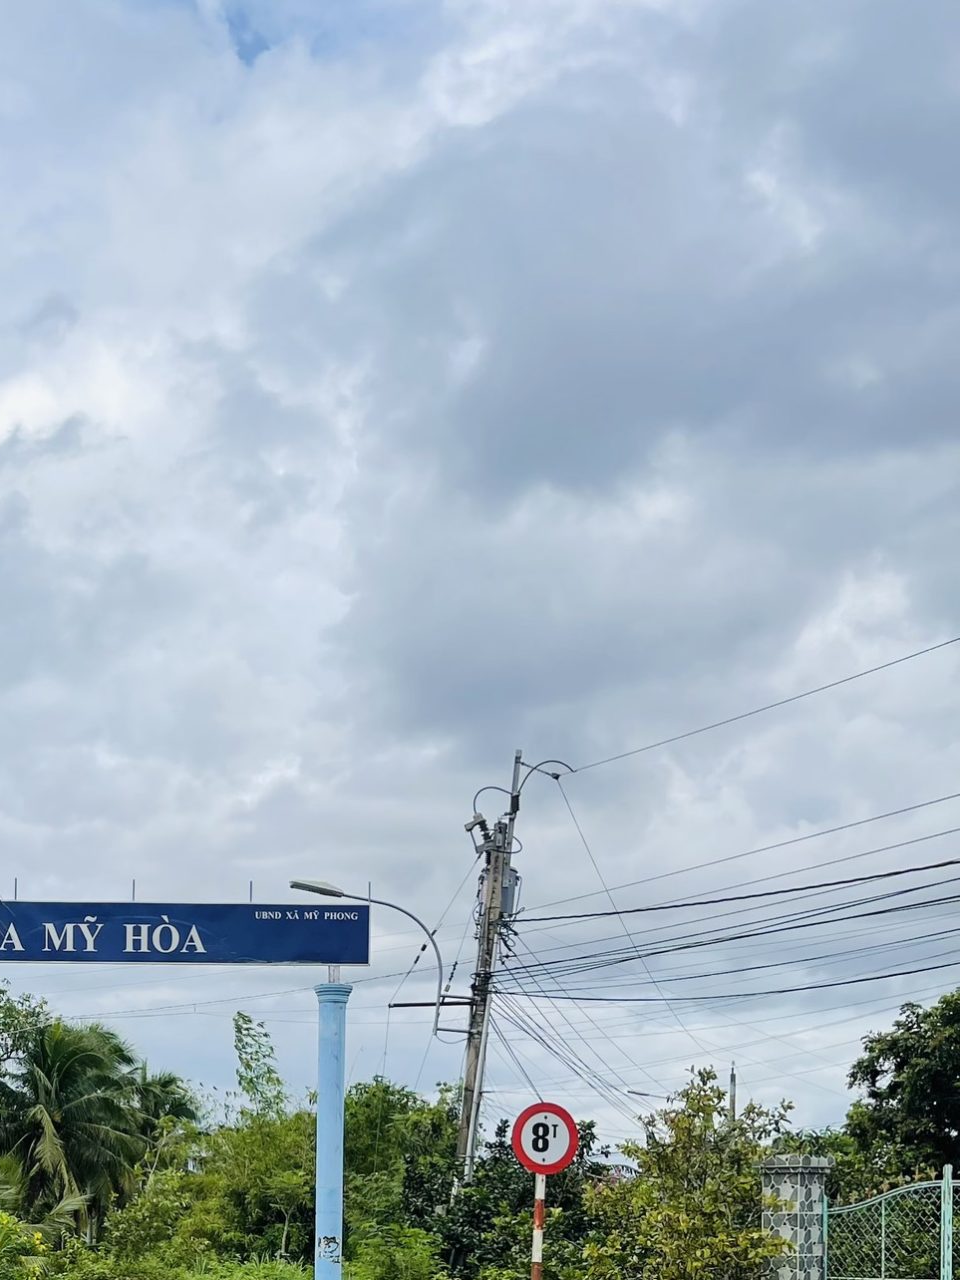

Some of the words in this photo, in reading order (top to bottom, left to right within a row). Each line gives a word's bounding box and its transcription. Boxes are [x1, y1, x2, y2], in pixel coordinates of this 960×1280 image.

[255, 911, 282, 919] UBND
[285, 910, 299, 920] XÃ
[303, 910, 320, 920] MỸ
[324, 911, 358, 921] PHONG
[41, 915, 105, 952] MỸ
[122, 914, 208, 953] HÒA
